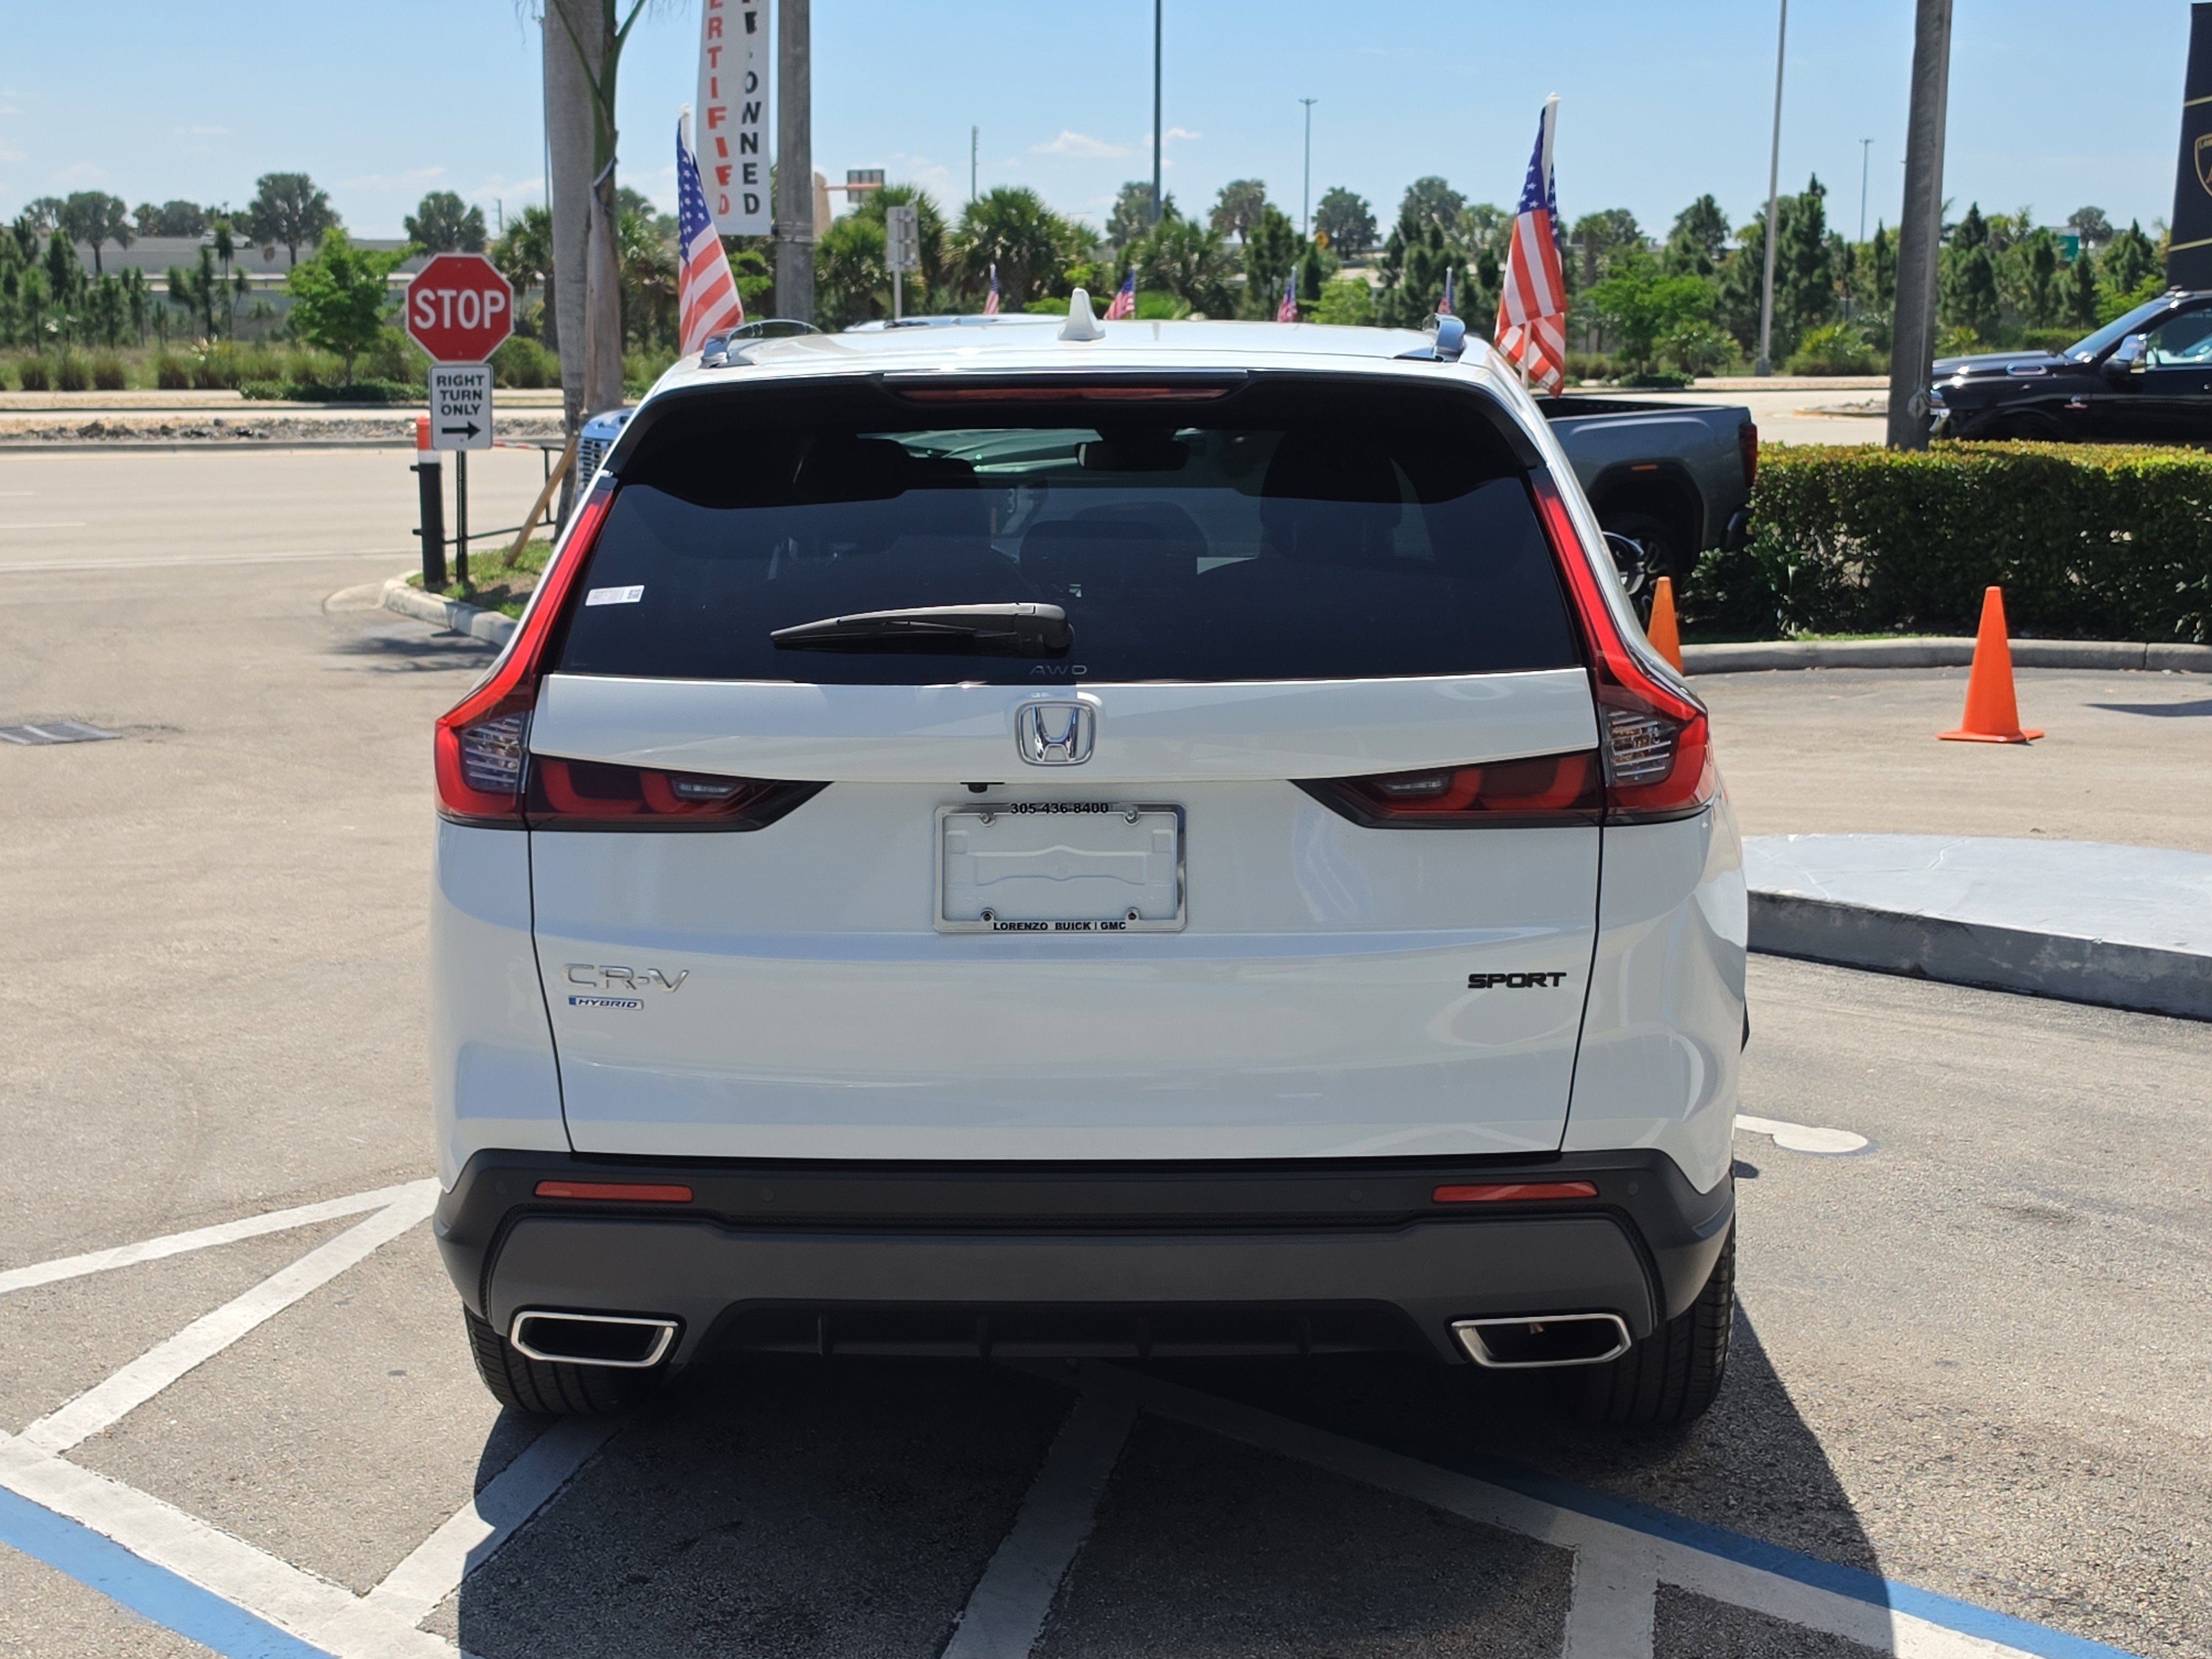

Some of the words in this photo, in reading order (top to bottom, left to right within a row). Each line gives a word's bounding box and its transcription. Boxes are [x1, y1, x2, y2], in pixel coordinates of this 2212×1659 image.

[414, 288, 505, 329] STOP
[436, 374, 485, 387] RIGHT
[440, 389, 483, 401] TURN
[441, 404, 481, 416] ONLY
[1030, 665, 1088, 675] AWD
[1010, 803, 1109, 814] 305-436-8400
[993, 922, 1049, 931] LORENZO
[1054, 922, 1091, 930] BUICK
[1100, 922, 1127, 930] GMC
[562, 963, 690, 993] CR-V
[1468, 972, 1567, 989] SPORT
[578, 999, 638, 1008] HYBRID
